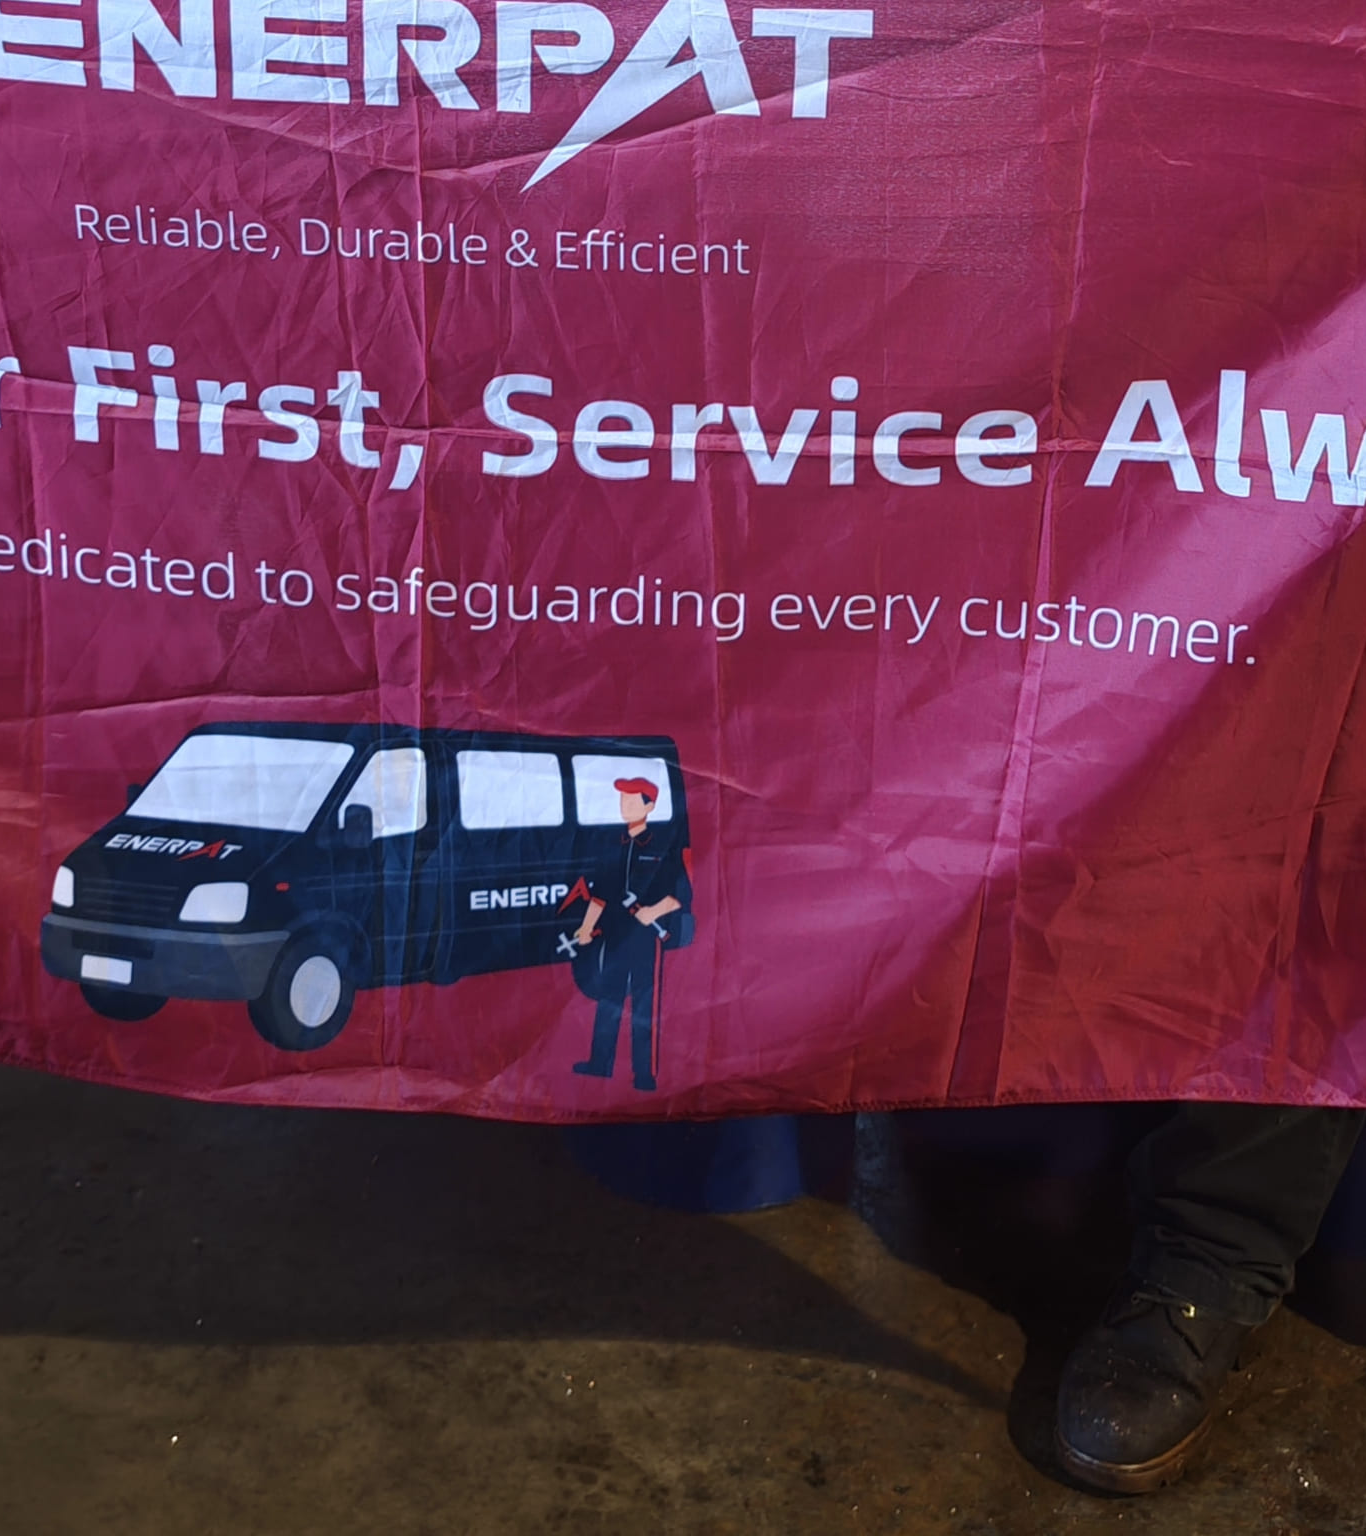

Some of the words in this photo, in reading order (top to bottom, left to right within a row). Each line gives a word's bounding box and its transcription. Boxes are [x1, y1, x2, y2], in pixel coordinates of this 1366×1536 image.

[74, 204, 280, 260] Reliable,
[300, 218, 488, 264] Durable
[505, 228, 539, 267] &
[556, 228, 750, 274] Efficient
[67, 344, 424, 490] First,
[482, 373, 1038, 486] Service
[254, 560, 313, 606] to
[336, 566, 745, 642] safeguarding
[770, 594, 940, 644] every
[960, 596, 1255, 664] customer.
[105, 832, 242, 860] ENERPAT
[469, 876, 595, 914] ENERPA
